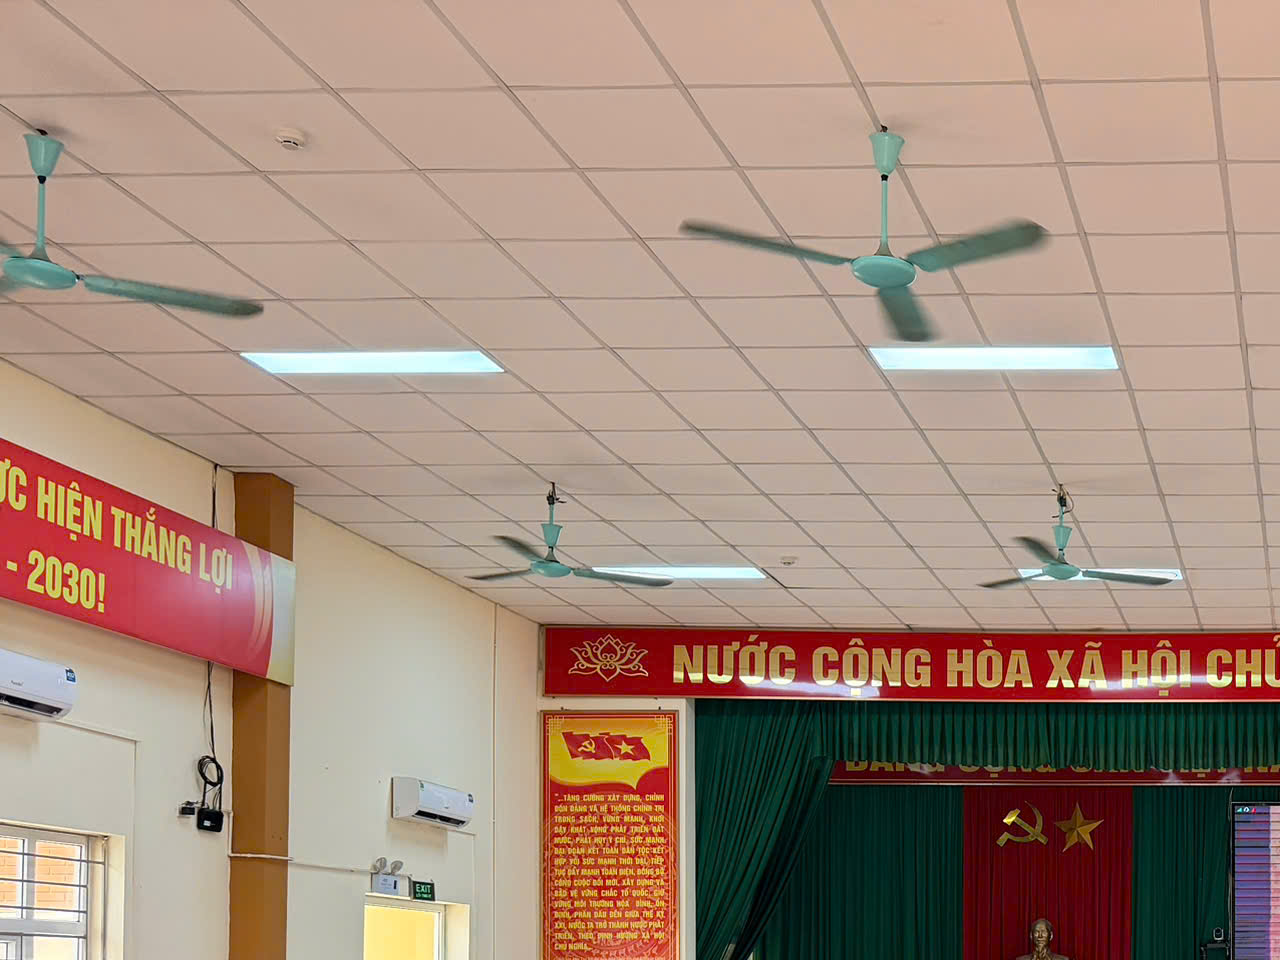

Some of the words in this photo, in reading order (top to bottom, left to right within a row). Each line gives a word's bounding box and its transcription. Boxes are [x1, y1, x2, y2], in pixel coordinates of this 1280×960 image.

[37, 476, 103, 542] HIỆN
[110, 506, 192, 575] THẮNG
[199, 542, 233, 594] LỢI
[27, 549, 106, 613] 2030!
[673, 634, 796, 686] NƯỚC
[812, 637, 931, 696] CỘNG
[946, 639, 1033, 688] HÒA
[1046, 641, 1107, 689] XÃ
[1121, 640, 1191, 696] HỘI
[416, 884, 431, 893] EXIT
